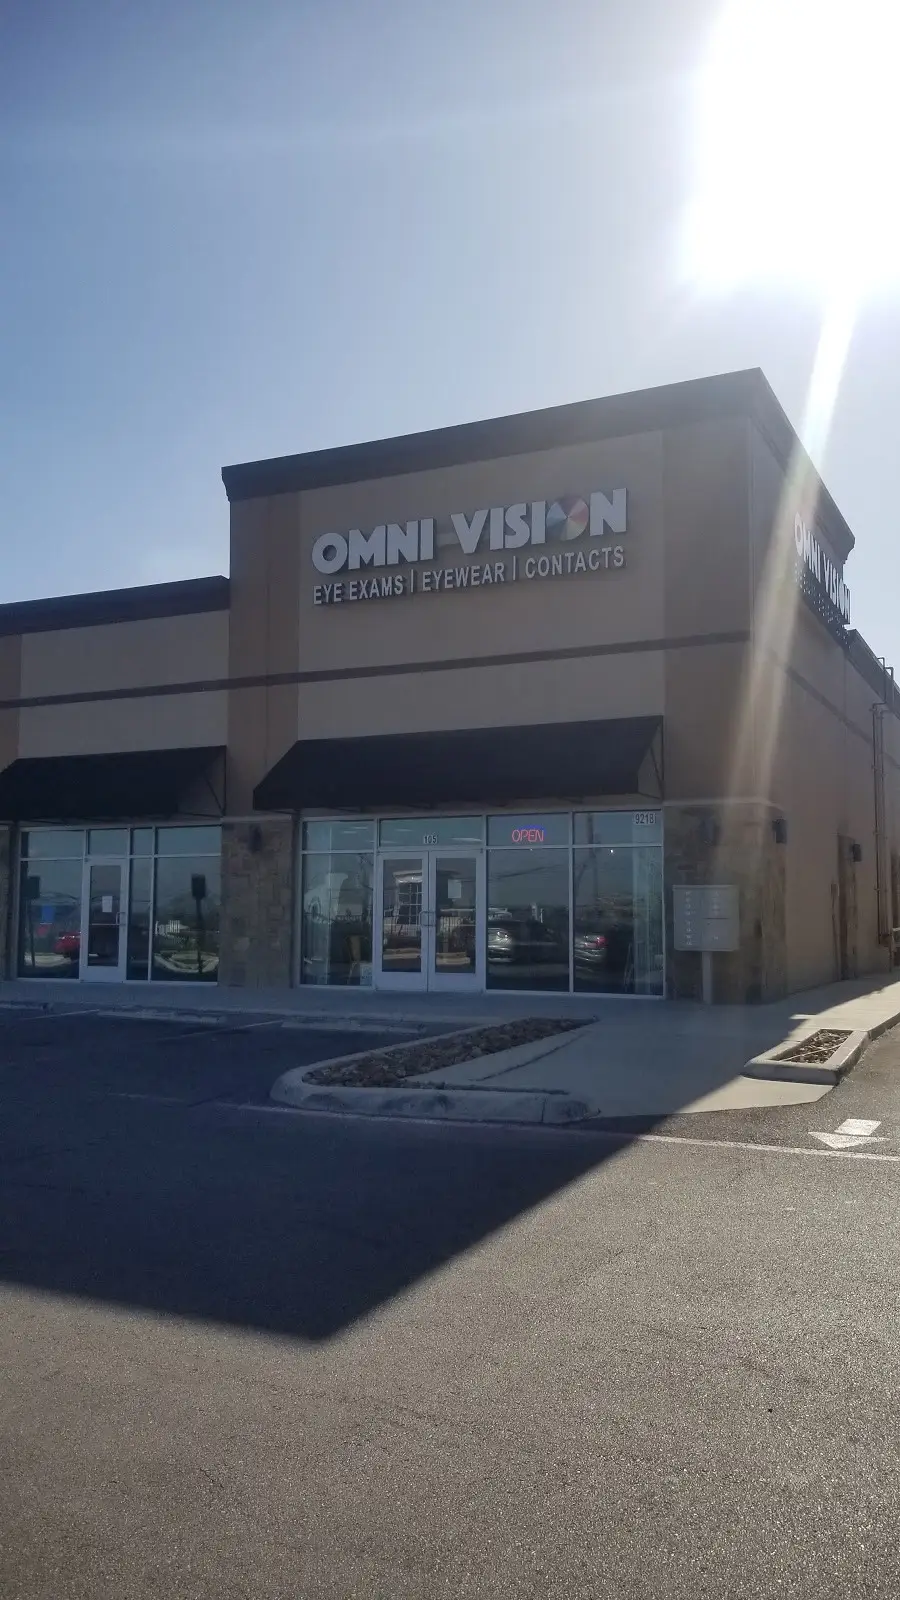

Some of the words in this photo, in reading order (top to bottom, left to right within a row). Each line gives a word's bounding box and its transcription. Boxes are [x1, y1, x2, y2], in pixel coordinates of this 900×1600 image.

[312, 517, 434, 575] OMNI
[450, 487, 627, 554] VISION
[794, 511, 821, 583] OMNI
[313, 583, 342, 605] EYE
[350, 575, 404, 600] EXAMS
[422, 562, 505, 592] EYEWEAR
[525, 545, 625, 579] CONTACTS
[424, 835, 437, 844] 105
[511, 829, 544, 843] OPEN
